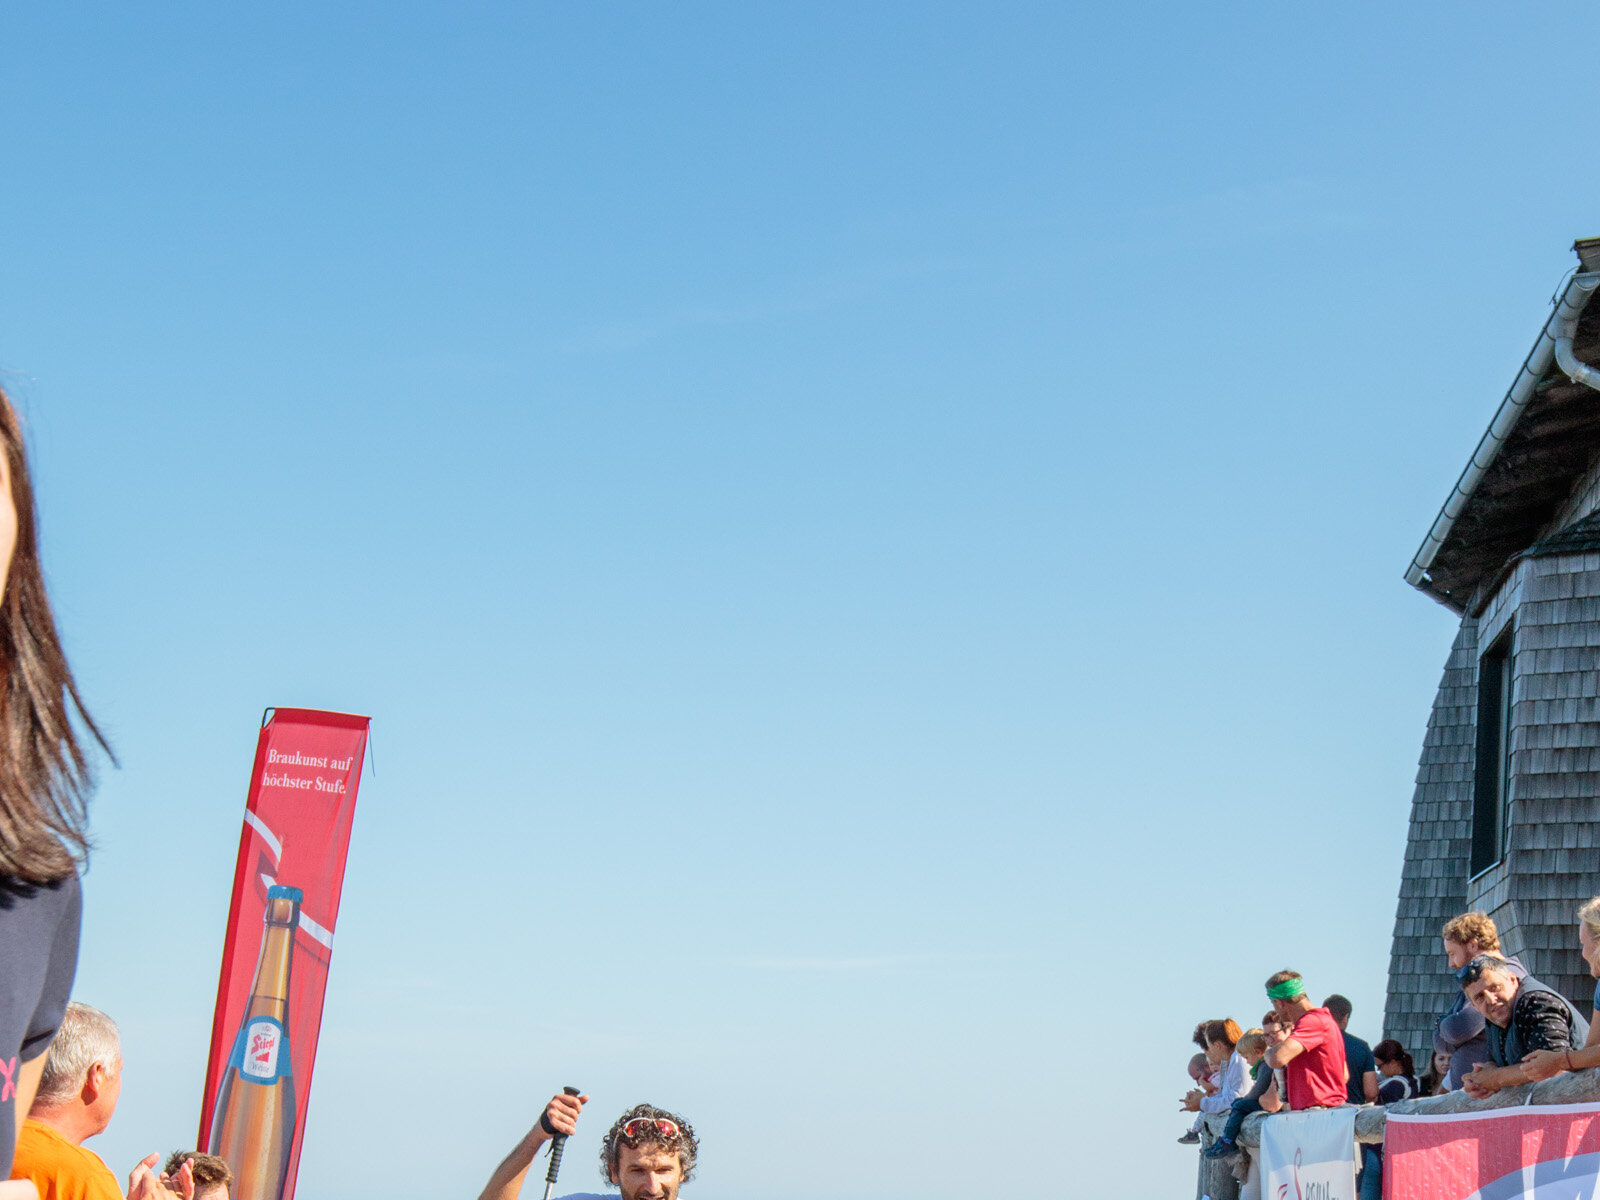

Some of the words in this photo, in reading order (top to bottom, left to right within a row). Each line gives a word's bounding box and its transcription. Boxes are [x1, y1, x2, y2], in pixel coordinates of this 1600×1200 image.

[268, 749, 328, 768] Braukunst
[330, 757, 353, 771] auf
[262, 773, 313, 790] höchster
[314, 776, 346, 794] Stufe.
